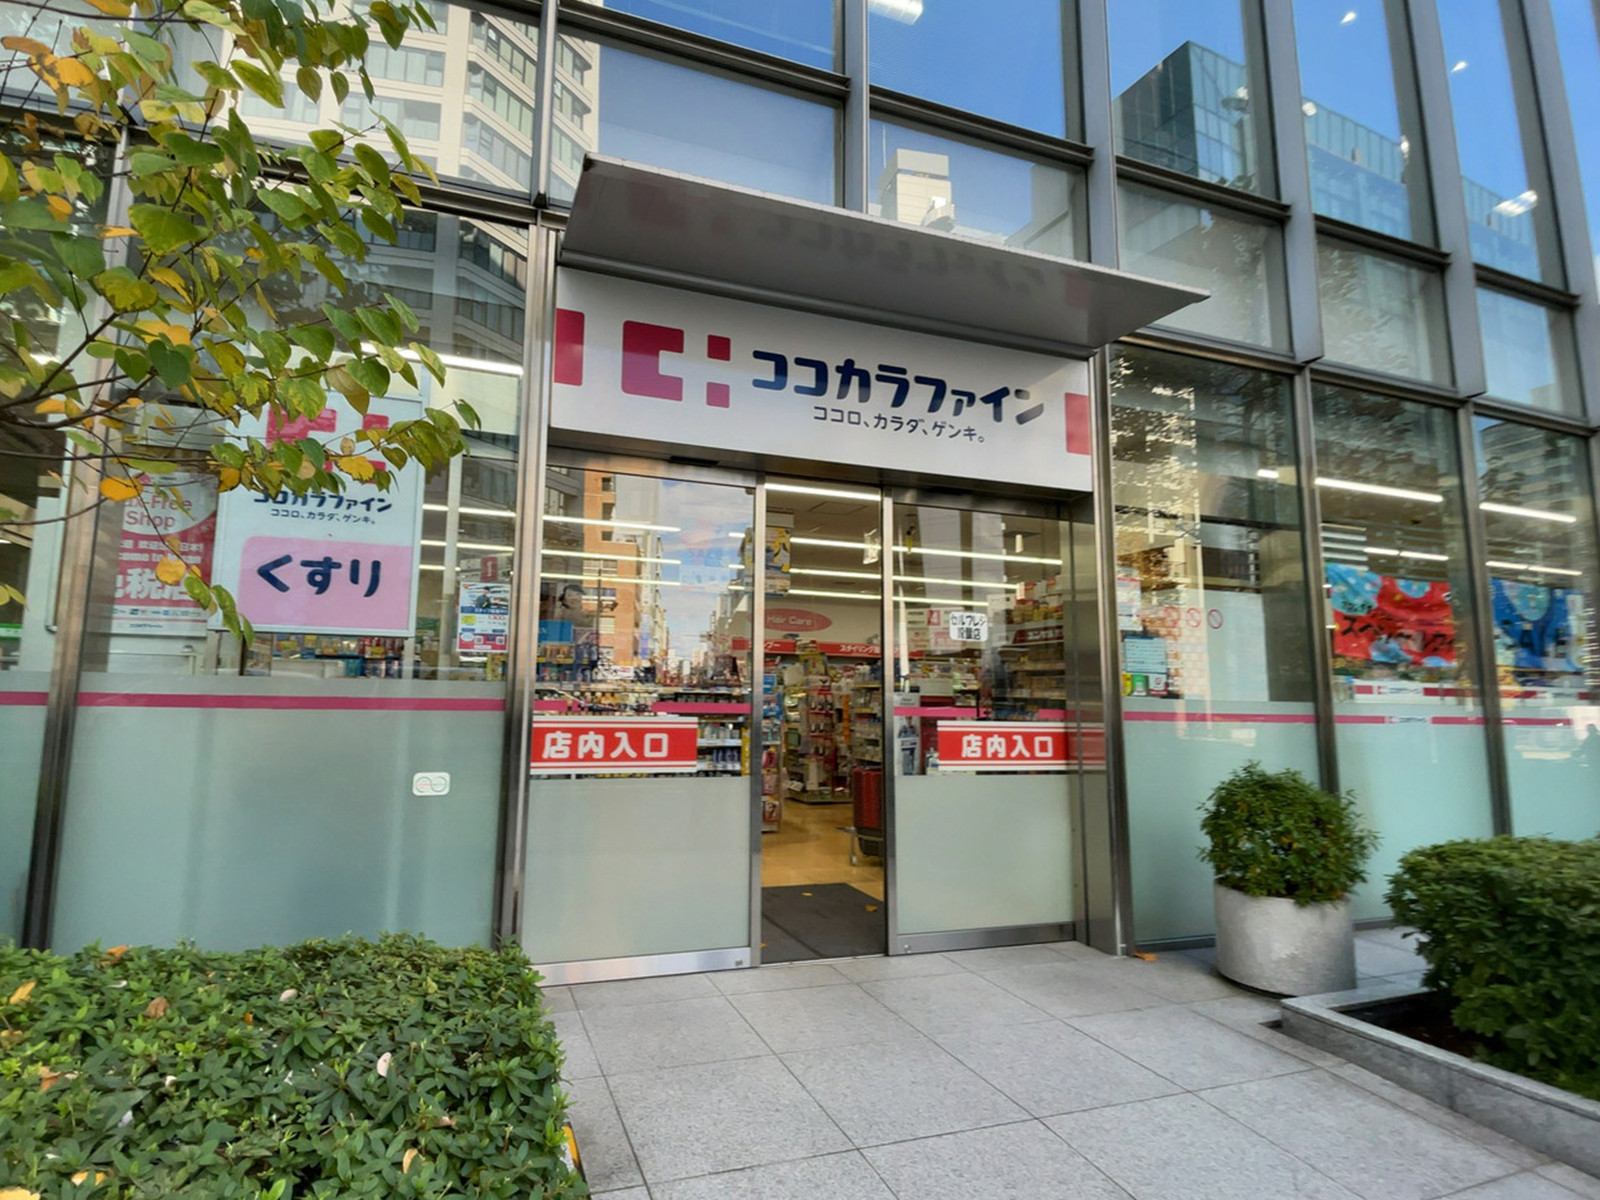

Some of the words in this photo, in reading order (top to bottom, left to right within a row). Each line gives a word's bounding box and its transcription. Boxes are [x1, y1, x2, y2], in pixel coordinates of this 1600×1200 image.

[752, 350, 1045, 425] ココカラファイン
[813, 406, 987, 444] ココロ、カラダ、ゲンキ。
[125, 510, 176, 531] Shop
[257, 554, 382, 598] くすり
[542, 731, 669, 759] 店内入口
[961, 734, 1054, 758] 店内入口
